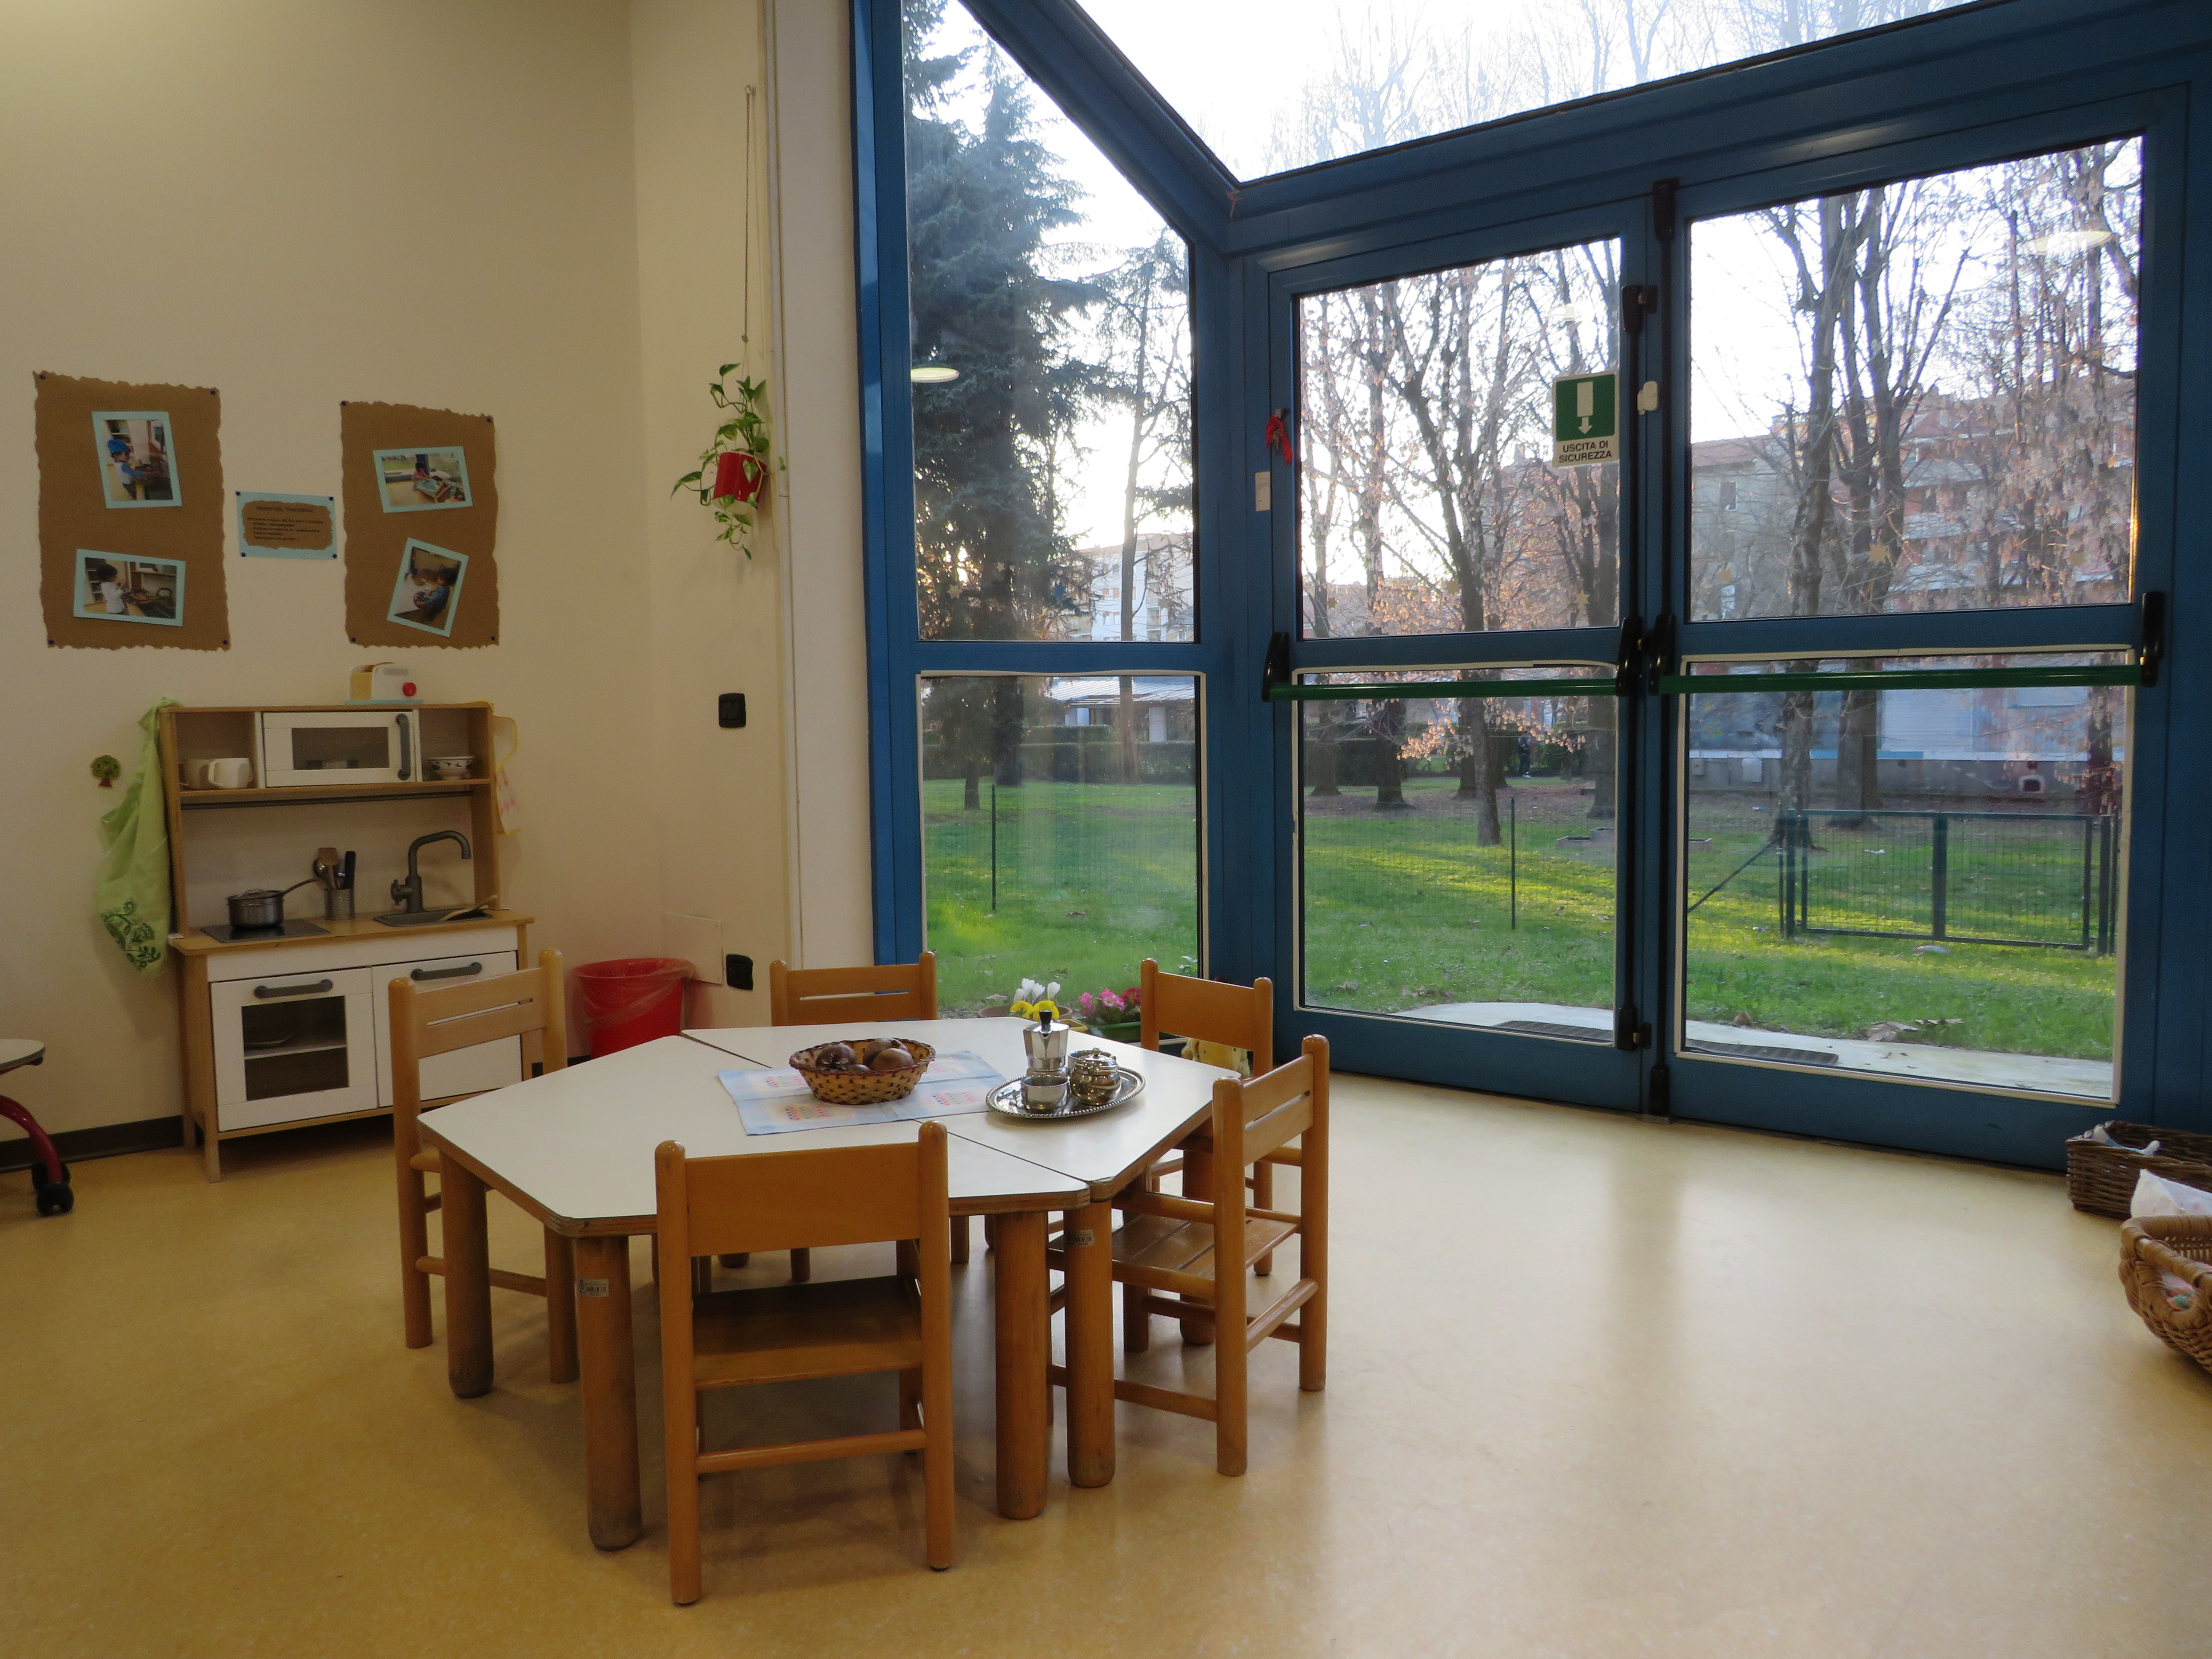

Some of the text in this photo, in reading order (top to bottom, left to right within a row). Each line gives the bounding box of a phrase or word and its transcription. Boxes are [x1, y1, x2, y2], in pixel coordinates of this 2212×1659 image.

[1563, 440, 1608, 453] USCITA DI
[1559, 450, 1612, 463] SICUREZZA
